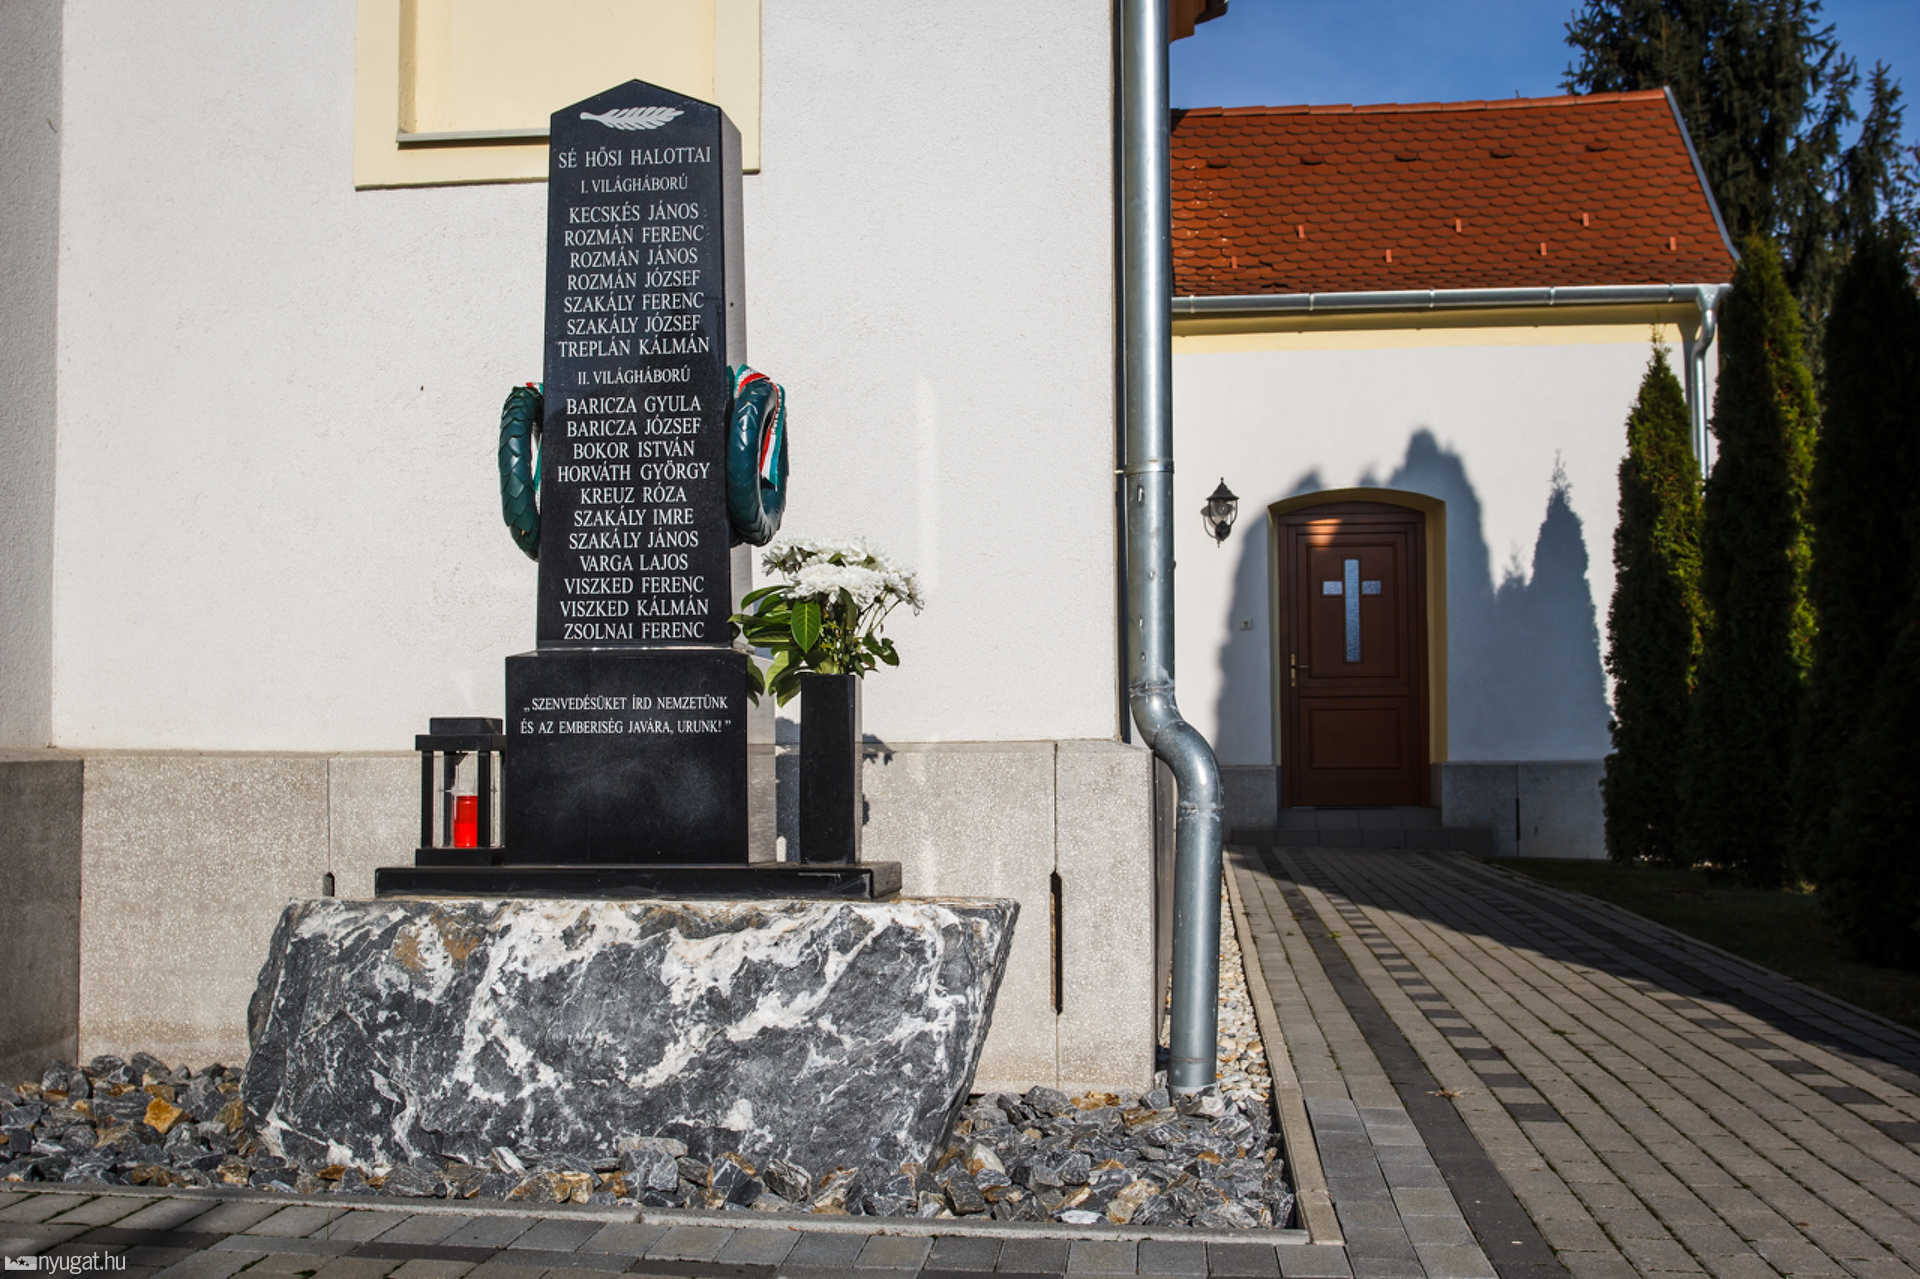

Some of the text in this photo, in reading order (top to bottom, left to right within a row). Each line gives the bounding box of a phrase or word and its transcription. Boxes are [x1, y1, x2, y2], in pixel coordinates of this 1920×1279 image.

[559, 148, 576, 168] SÉ
[631, 147, 710, 165] HALOTTAI
[581, 175, 687, 193] I. VILÁGHÁBORÚ
[570, 200, 698, 223] KECSKÉS JÁNOS
[565, 225, 703, 246] ROZMÁN FERENC
[571, 245, 697, 268] ROZMÁN JÁNOS
[568, 268, 700, 290] ROZMÁN JÓZSEF
[564, 292, 704, 313] SZAKÁLY FERENC
[567, 313, 700, 335] SZAKÁLY JÓZSEF
[558, 334, 709, 357] TREPLÁN KÁLMÁN
[579, 366, 690, 384] II. VILÁGHÁBORÚ
[567, 396, 701, 414] BARICZA GYULA
[568, 415, 701, 437] BARICZA JÓZSEF
[574, 437, 694, 459] BOKOR ISTVÁN
[558, 460, 710, 482] HORVÁTH GYÖRGY
[581, 482, 686, 504] KREUZ RÓZA
[575, 506, 693, 526] SZAKÁLY IMRE
[570, 528, 698, 549] SZAKÁLY JÁNOS
[580, 553, 688, 571] VARGA LAJOS
[564, 576, 704, 594] VISZKED FERENC
[560, 596, 708, 617] VISZKED KÁLMÁN
[564, 622, 704, 639] ZSOLNAI FERENC
[633, 694, 651, 709] ÍRD
[657, 694, 727, 709] NEMZETÜNK
[521, 718, 534, 733] ÉS
[539, 721, 553, 733] AZ
[560, 718, 623, 733] EMBERISÉG
[628, 718, 673, 733] JAVÁRA,
